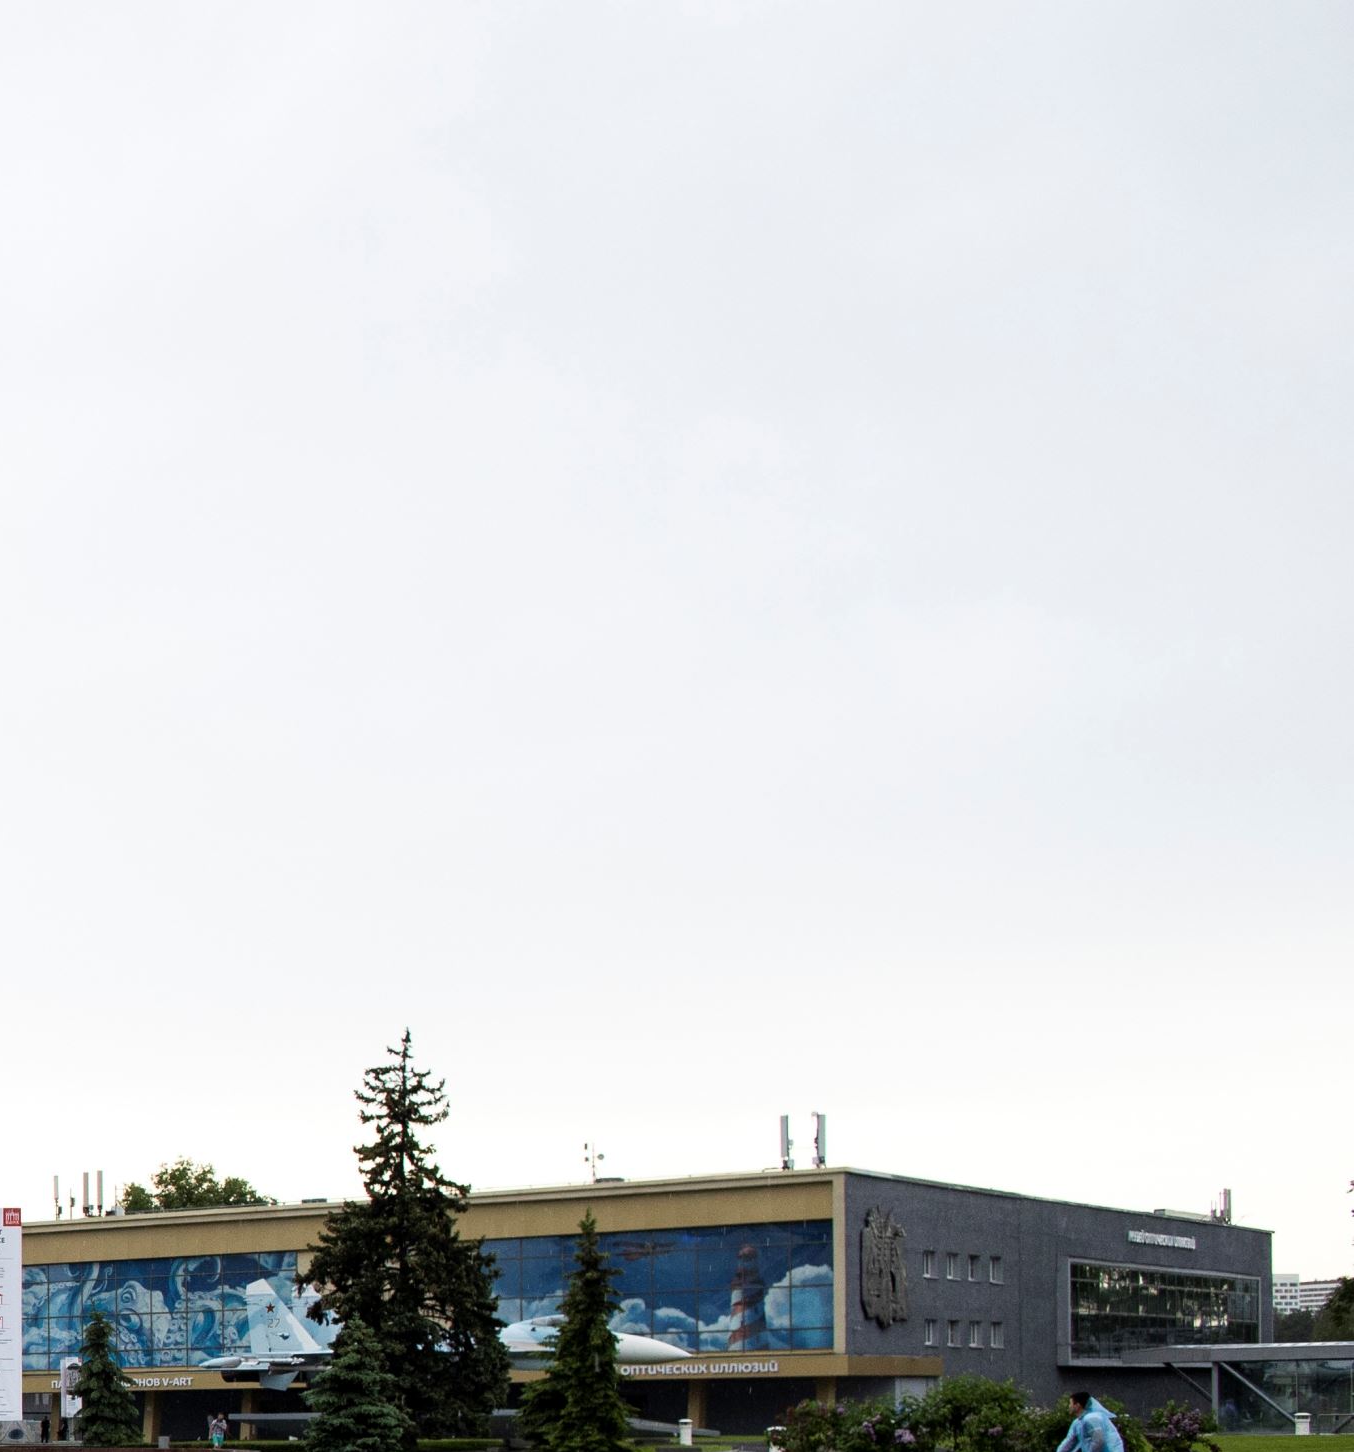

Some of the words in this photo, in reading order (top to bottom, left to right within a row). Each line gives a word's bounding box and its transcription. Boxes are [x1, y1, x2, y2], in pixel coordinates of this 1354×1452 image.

[267, 1318, 281, 1328] 27
[620, 1363, 708, 1376] ОПТИЧЕСКИХ
[710, 1360, 779, 1374] ИЛЛЮЗИЙ
[162, 1377, 193, 1387] V-ART
